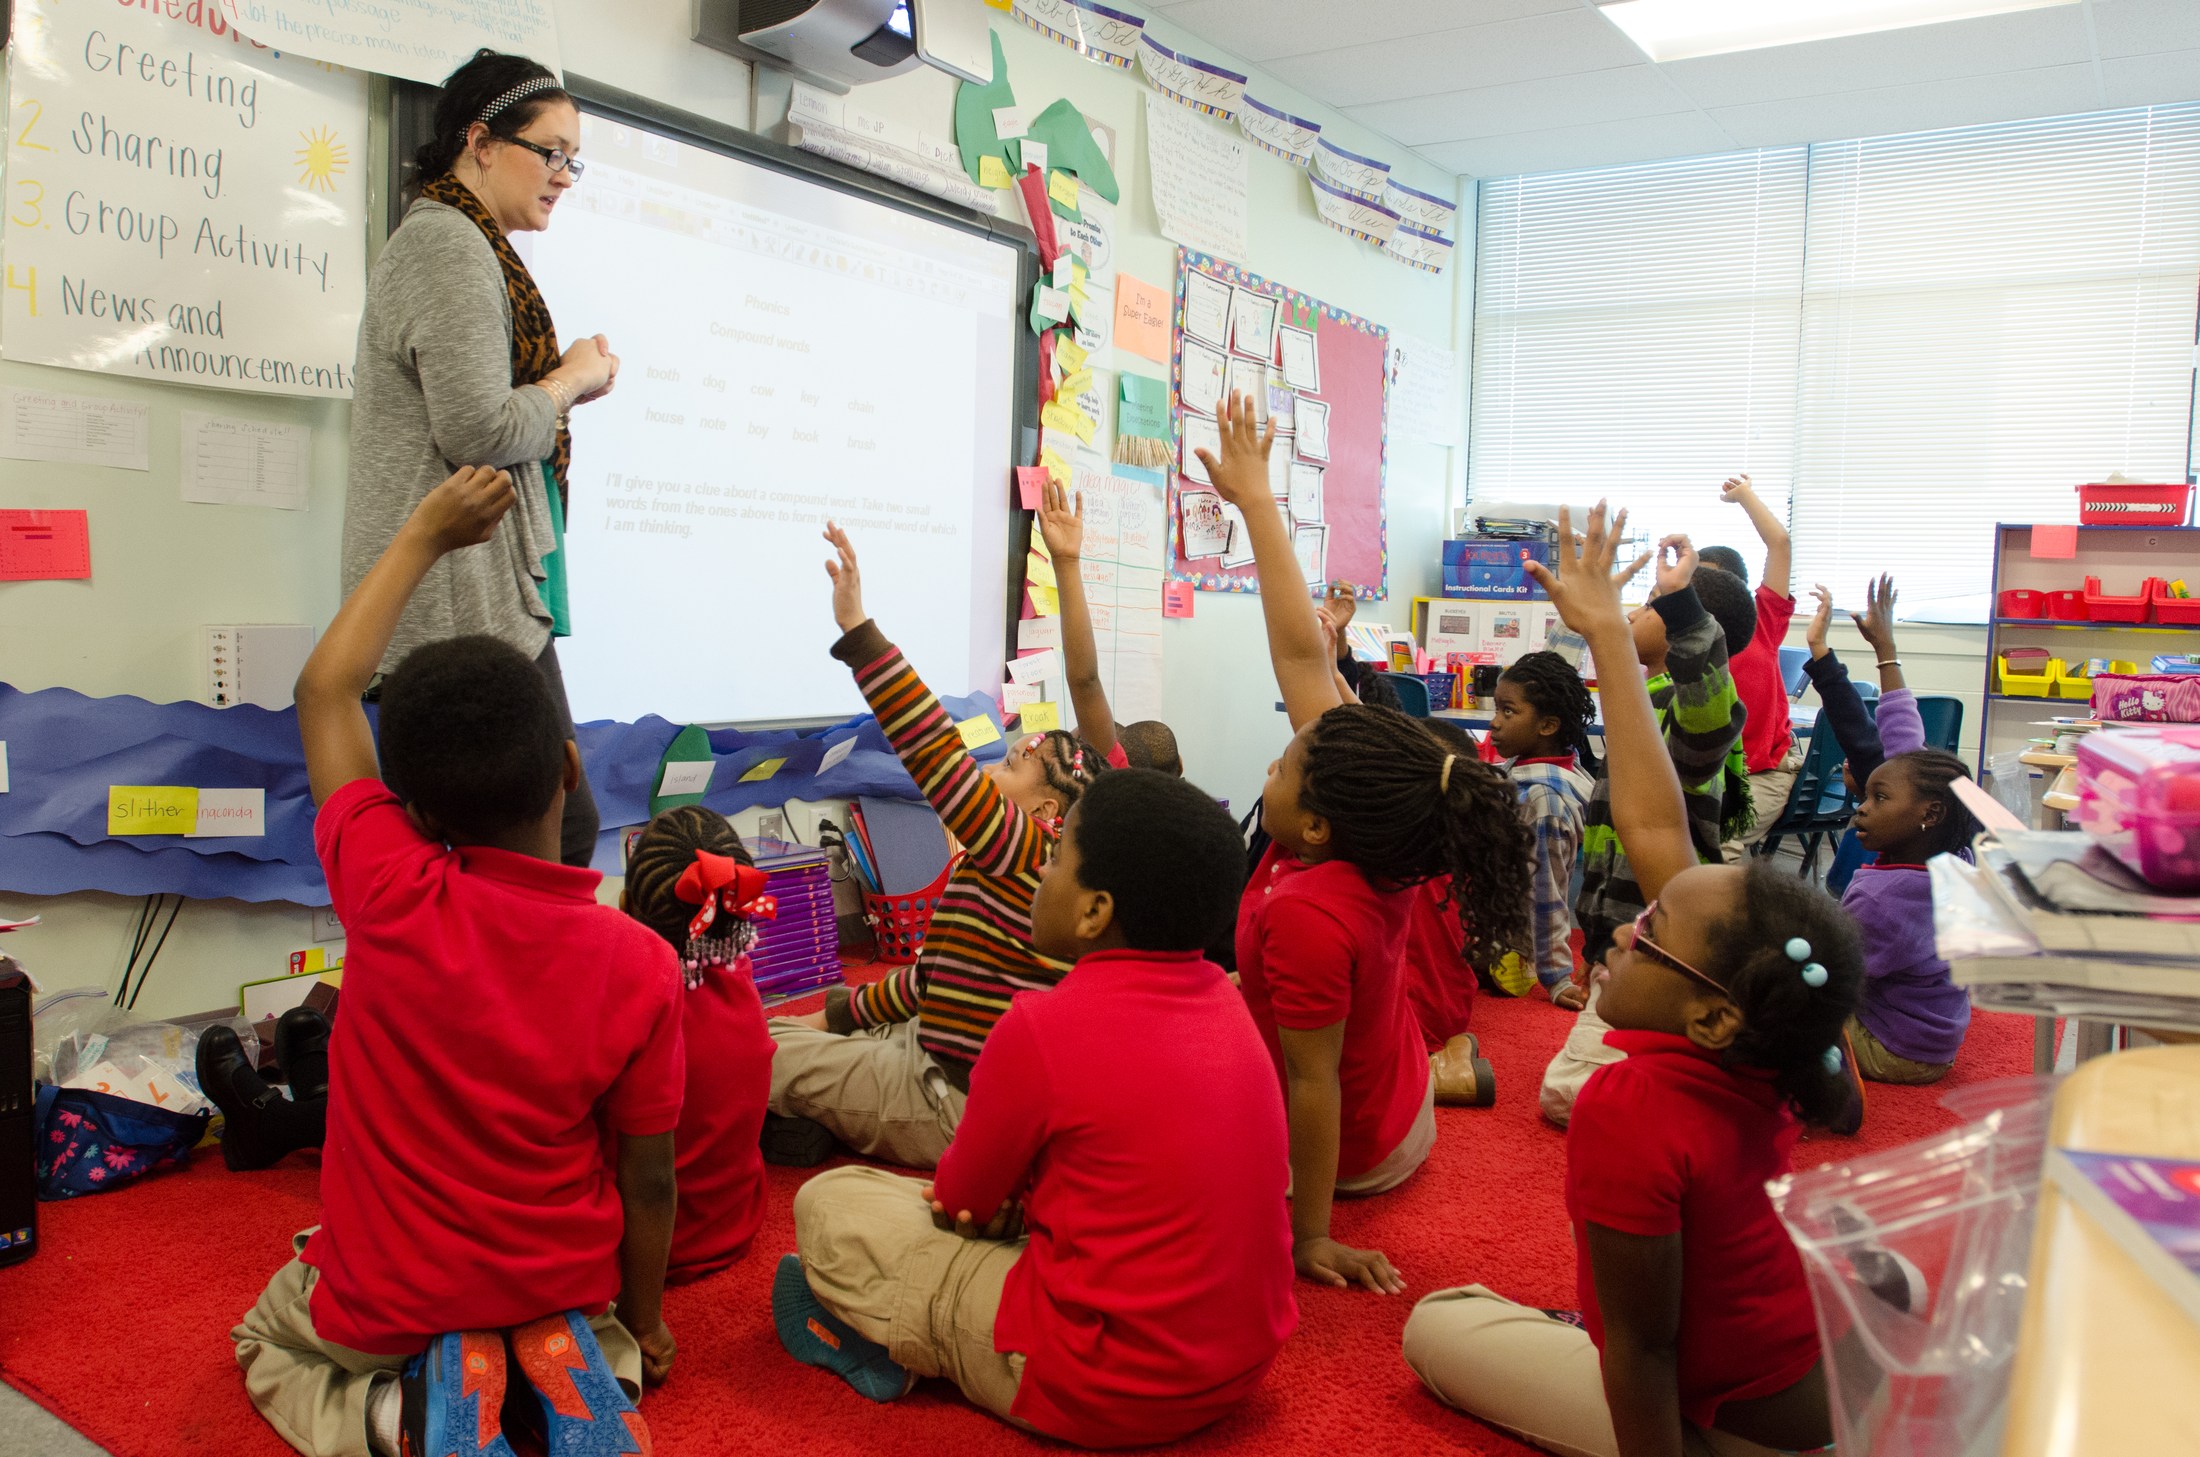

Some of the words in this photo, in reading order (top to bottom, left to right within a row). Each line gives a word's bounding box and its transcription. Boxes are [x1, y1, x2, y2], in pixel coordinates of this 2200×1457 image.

[65, 190, 178, 259] Group
[62, 275, 155, 325] News
[168, 302, 224, 340] and
[744, 294, 791, 316] Phonics
[1123, 304, 1142, 320] Super
[709, 321, 774, 348] Compound
[776, 337, 811, 354] words
[646, 364, 681, 383] tooth
[702, 374, 726, 393] dog
[750, 384, 775, 397] cow
[800, 389, 820, 407] key
[847, 399, 875, 415] chain
[645, 407, 685, 426] house
[699, 417, 728, 431] note
[747, 421, 770, 440] boy
[792, 428, 820, 443] book
[847, 436, 877, 452] brush
[625, 475, 653, 493] give
[656, 481, 680, 495] you
[683, 484, 692, 494] a
[694, 482, 720, 497] clue
[723, 485, 757, 500] about
[759, 490, 768, 501] a
[769, 491, 828, 508] compound
[861, 497, 883, 512] Take
[886, 502, 903, 514] two
[905, 504, 931, 517] small
[604, 516, 611, 530] I
[613, 520, 635, 533] am
[639, 518, 693, 540] thinking.
[606, 497, 647, 511] words
[651, 498, 681, 514] from
[685, 501, 705, 516] the
[707, 505, 737, 518] ones
[740, 508, 775, 521] above
[777, 510, 790, 522] to
[792, 509, 817, 522] form
[840, 516, 892, 532] compound
[894, 519, 919, 533] word
[919, 521, 929, 534] of
[931, 523, 958, 536] which
[1445, 584, 1492, 594] Instructional
[1492, 585, 1515, 594] Cards
[1516, 585, 1528, 594] Kit
[2118, 696, 2140, 711] Hello
[2120, 705, 2142, 719] Kitty
[670, 773, 697, 785] island
[114, 798, 185, 818] slither
